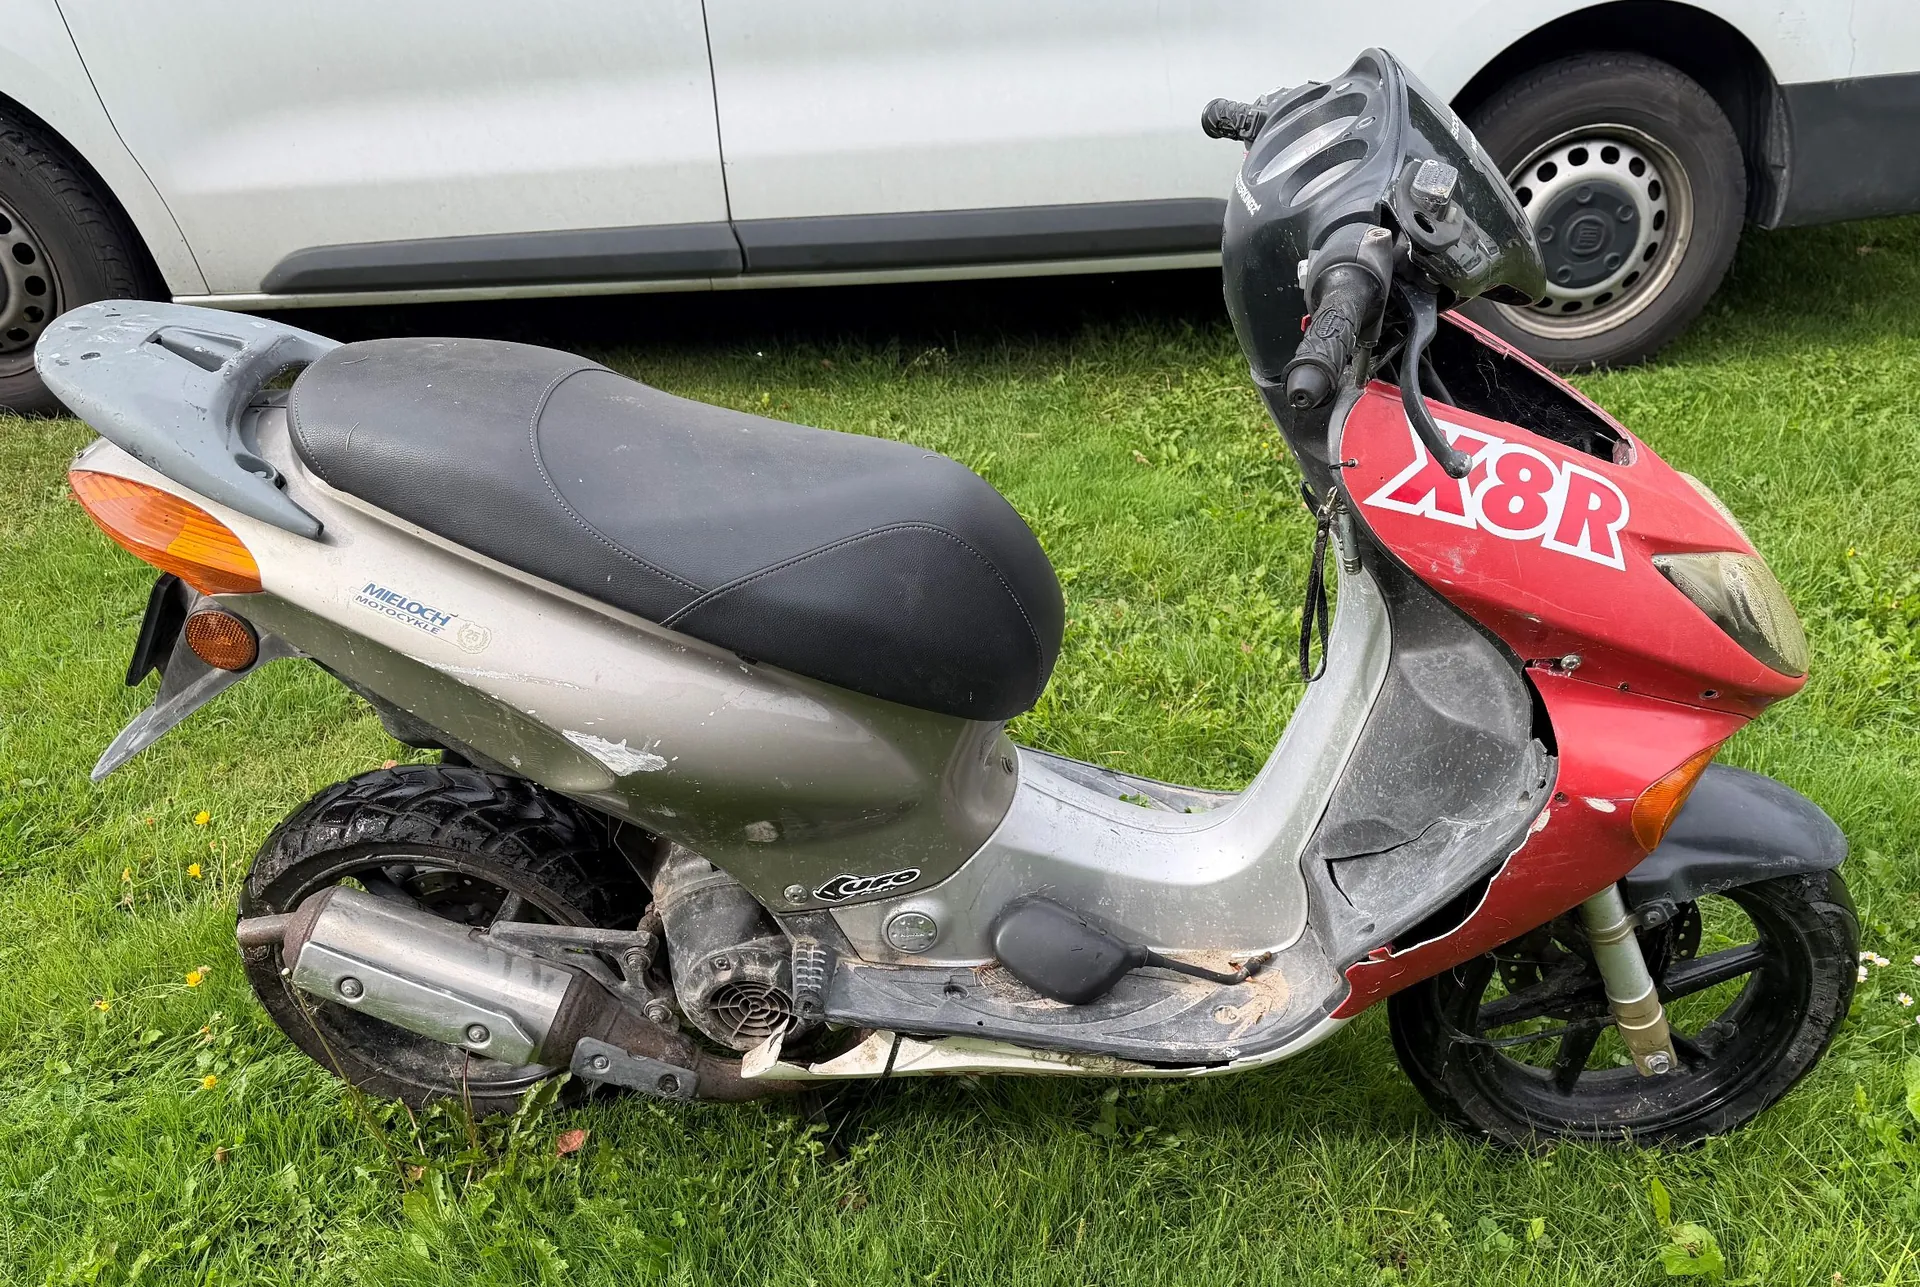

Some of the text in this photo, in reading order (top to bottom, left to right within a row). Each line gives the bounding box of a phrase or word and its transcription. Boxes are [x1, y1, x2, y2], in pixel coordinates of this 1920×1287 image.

[1362, 414, 1630, 571] X8R
[355, 595, 440, 635] MOTOCYKLE
[362, 582, 451, 627] MIELOCH
[464, 629, 481, 643] 25
[838, 867, 921, 895] UFO
